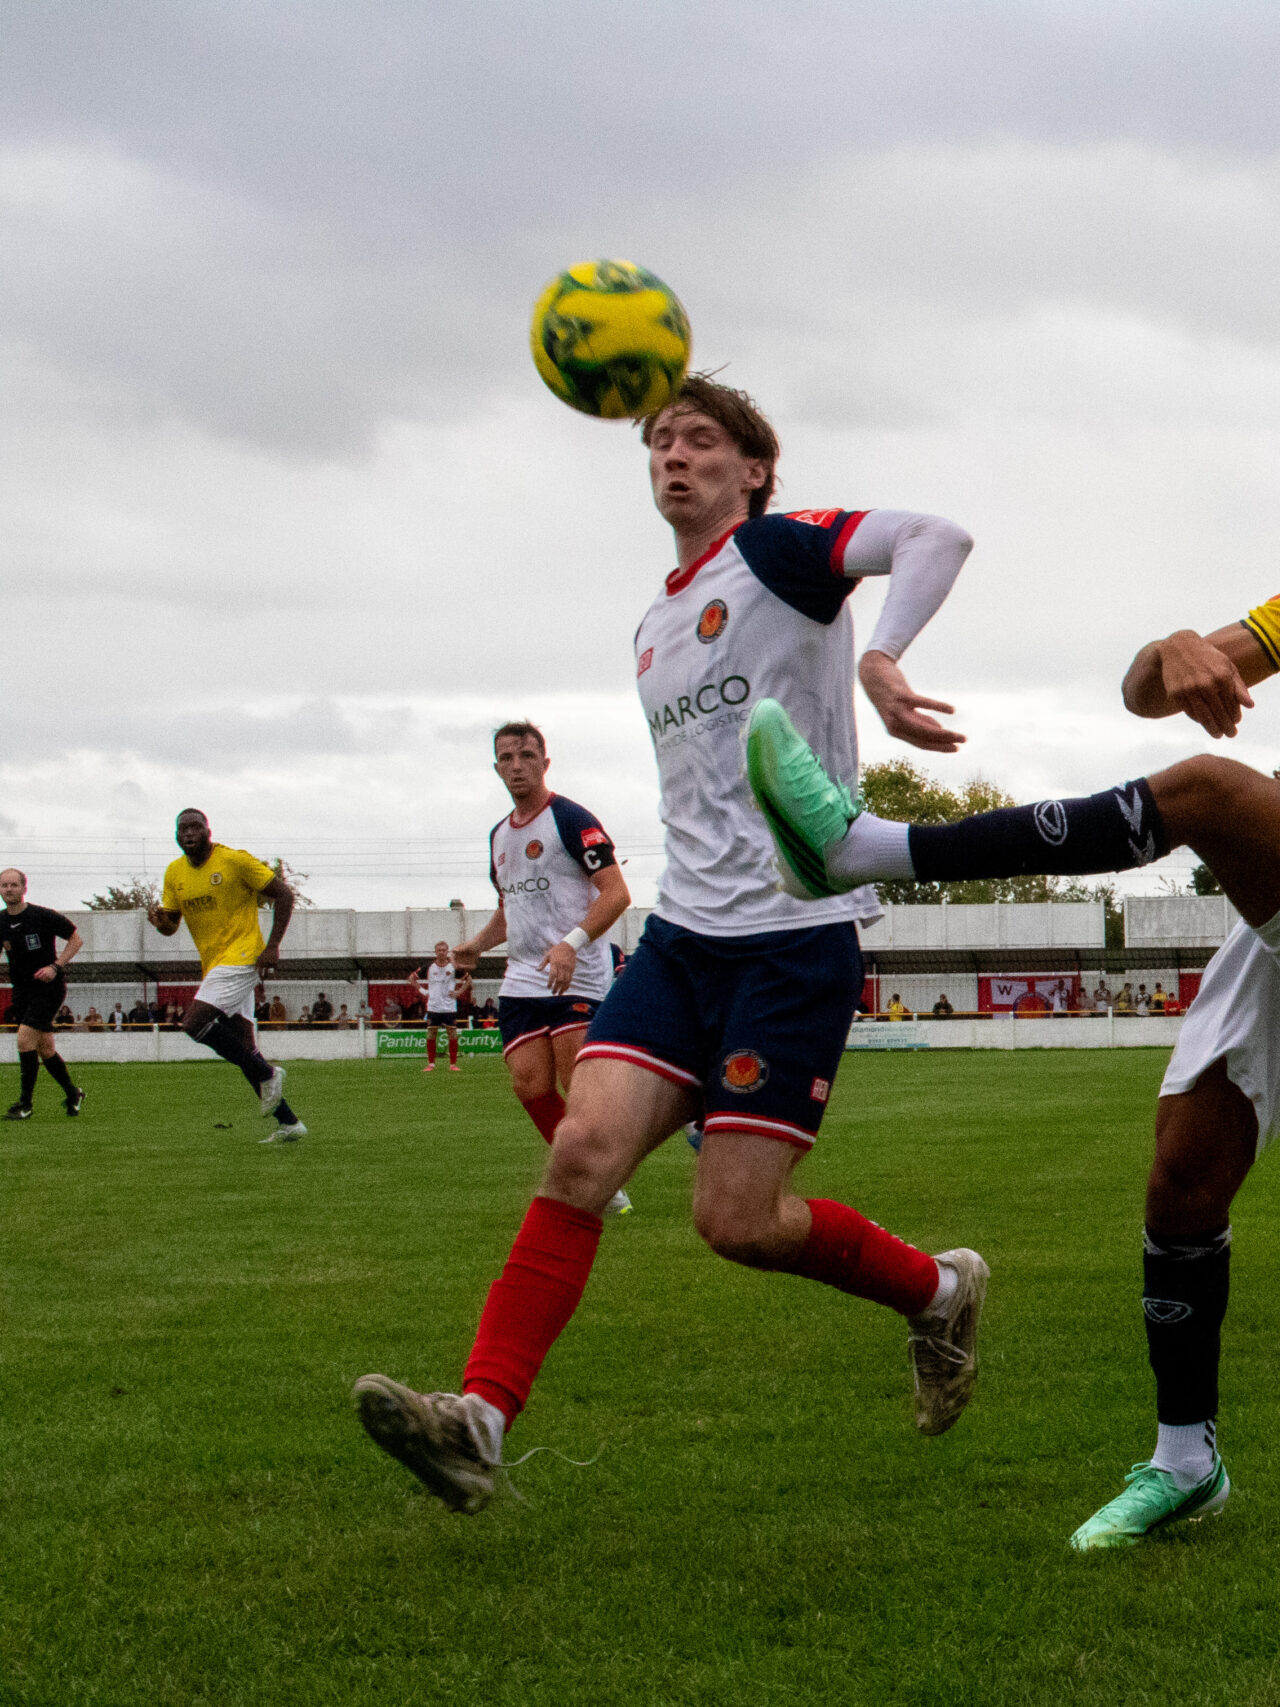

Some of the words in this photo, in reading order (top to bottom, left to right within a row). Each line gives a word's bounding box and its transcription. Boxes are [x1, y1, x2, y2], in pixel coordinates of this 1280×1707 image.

[689, 708, 755, 738] LOGISTIC
[583, 850, 602, 870] C
[998, 985, 1012, 996] W
[379, 1034, 427, 1048] Panthe
[438, 1033, 499, 1048] Scurity
